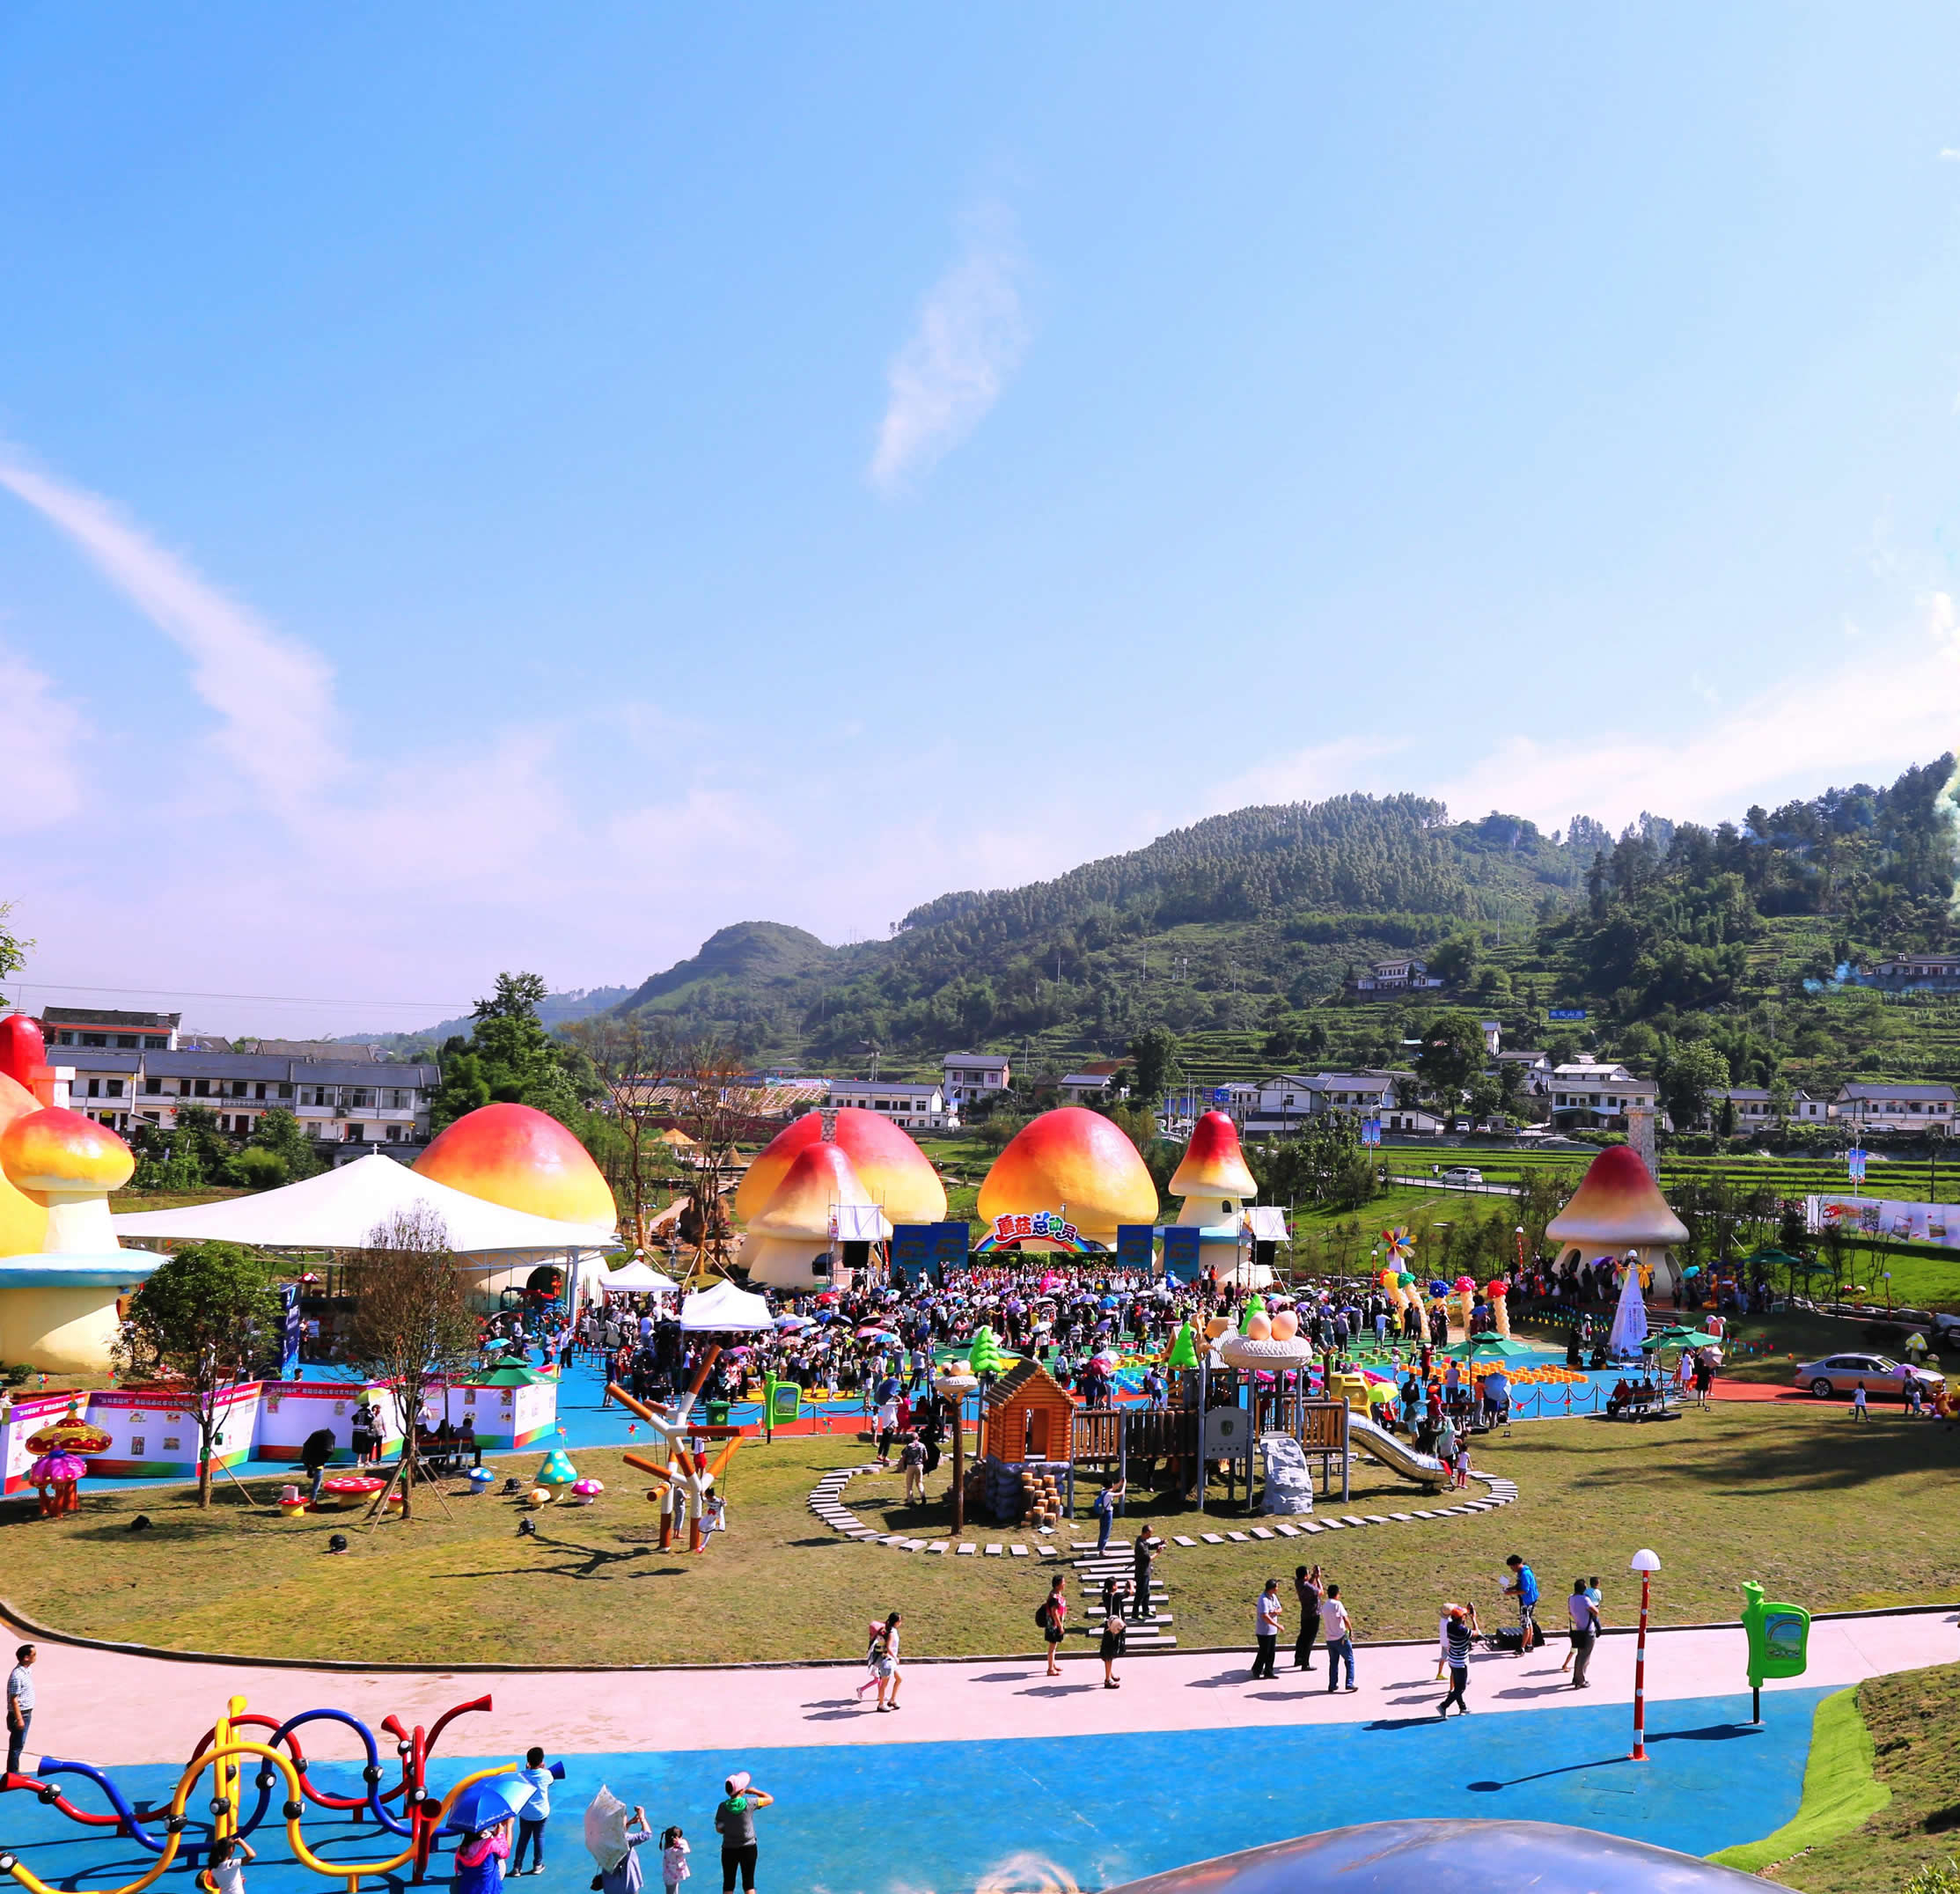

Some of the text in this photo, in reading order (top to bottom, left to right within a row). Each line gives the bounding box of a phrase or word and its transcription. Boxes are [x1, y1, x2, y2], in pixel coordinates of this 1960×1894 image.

[995, 1212, 1076, 1242] 蘑菇总动员
